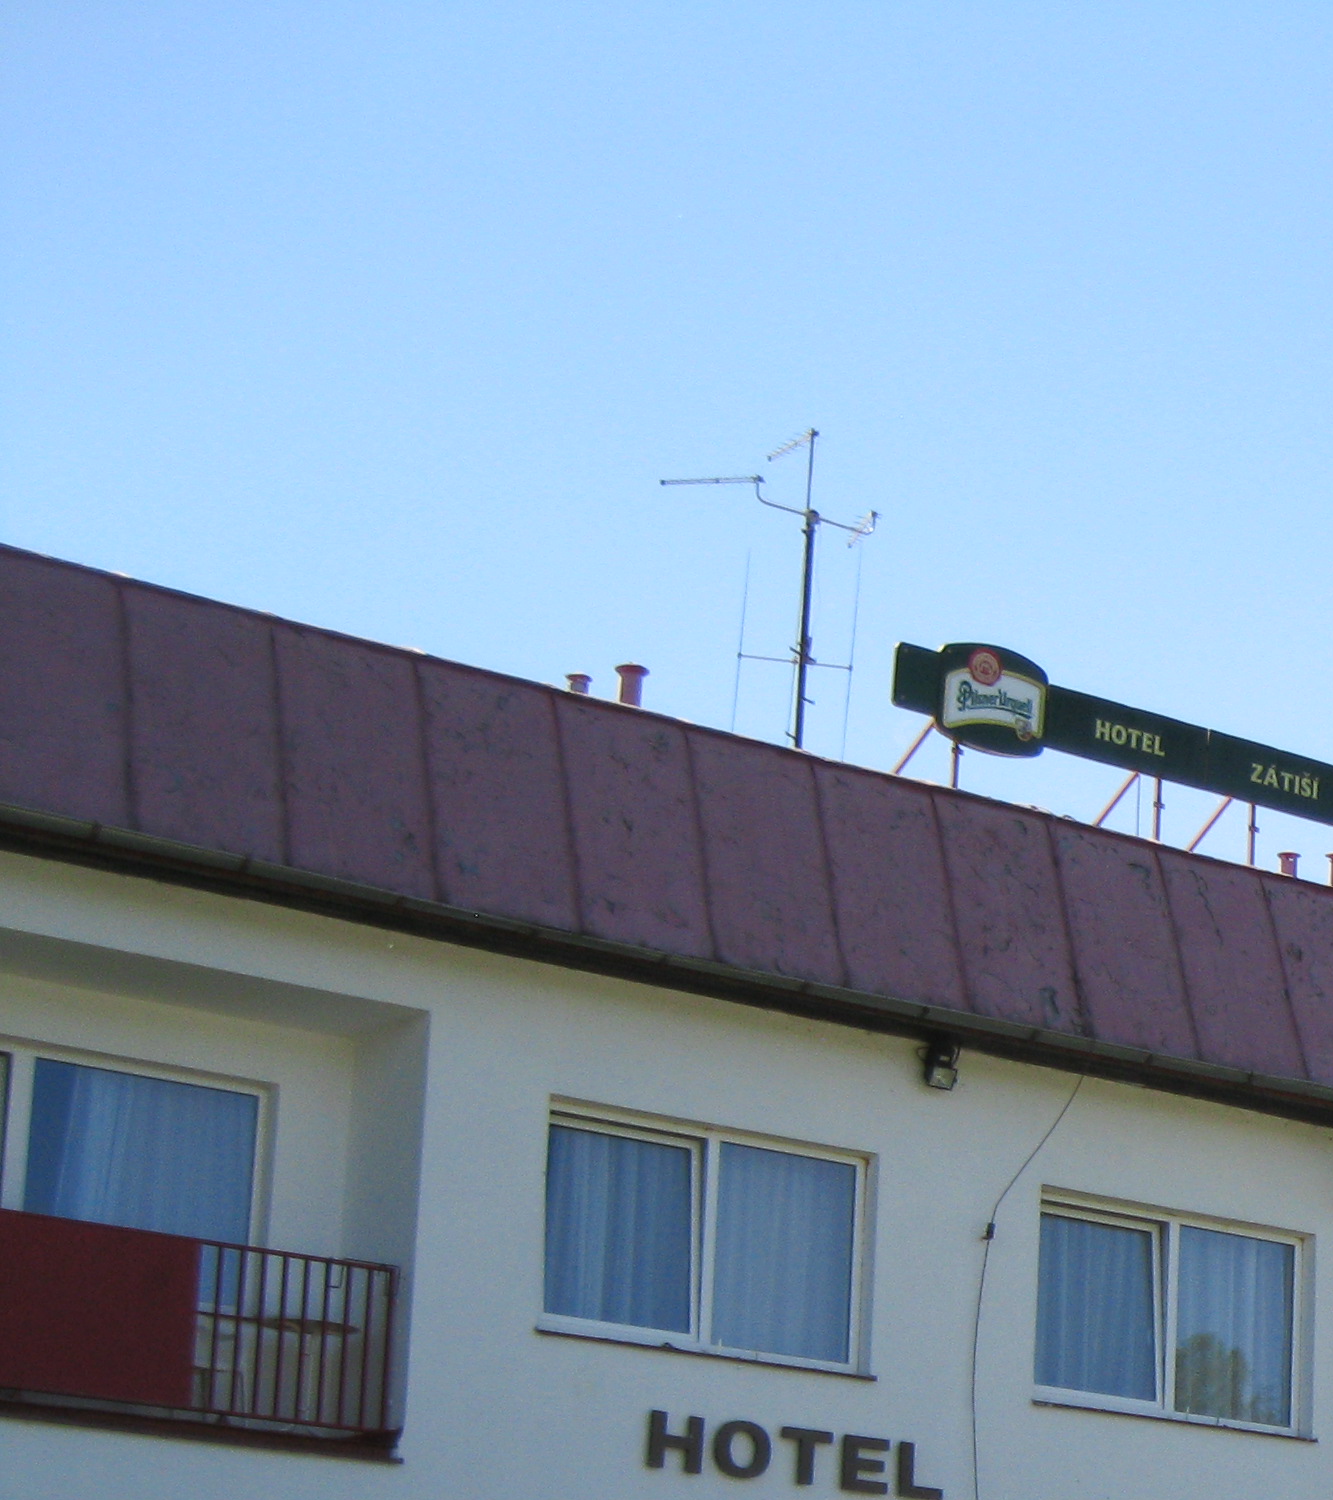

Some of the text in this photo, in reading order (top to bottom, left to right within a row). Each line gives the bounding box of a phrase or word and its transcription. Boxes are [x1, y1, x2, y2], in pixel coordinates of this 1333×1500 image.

[1095, 718, 1321, 800] HOTEL ZÁTIŠÍ
[646, 1409, 944, 1500] HOTEL
